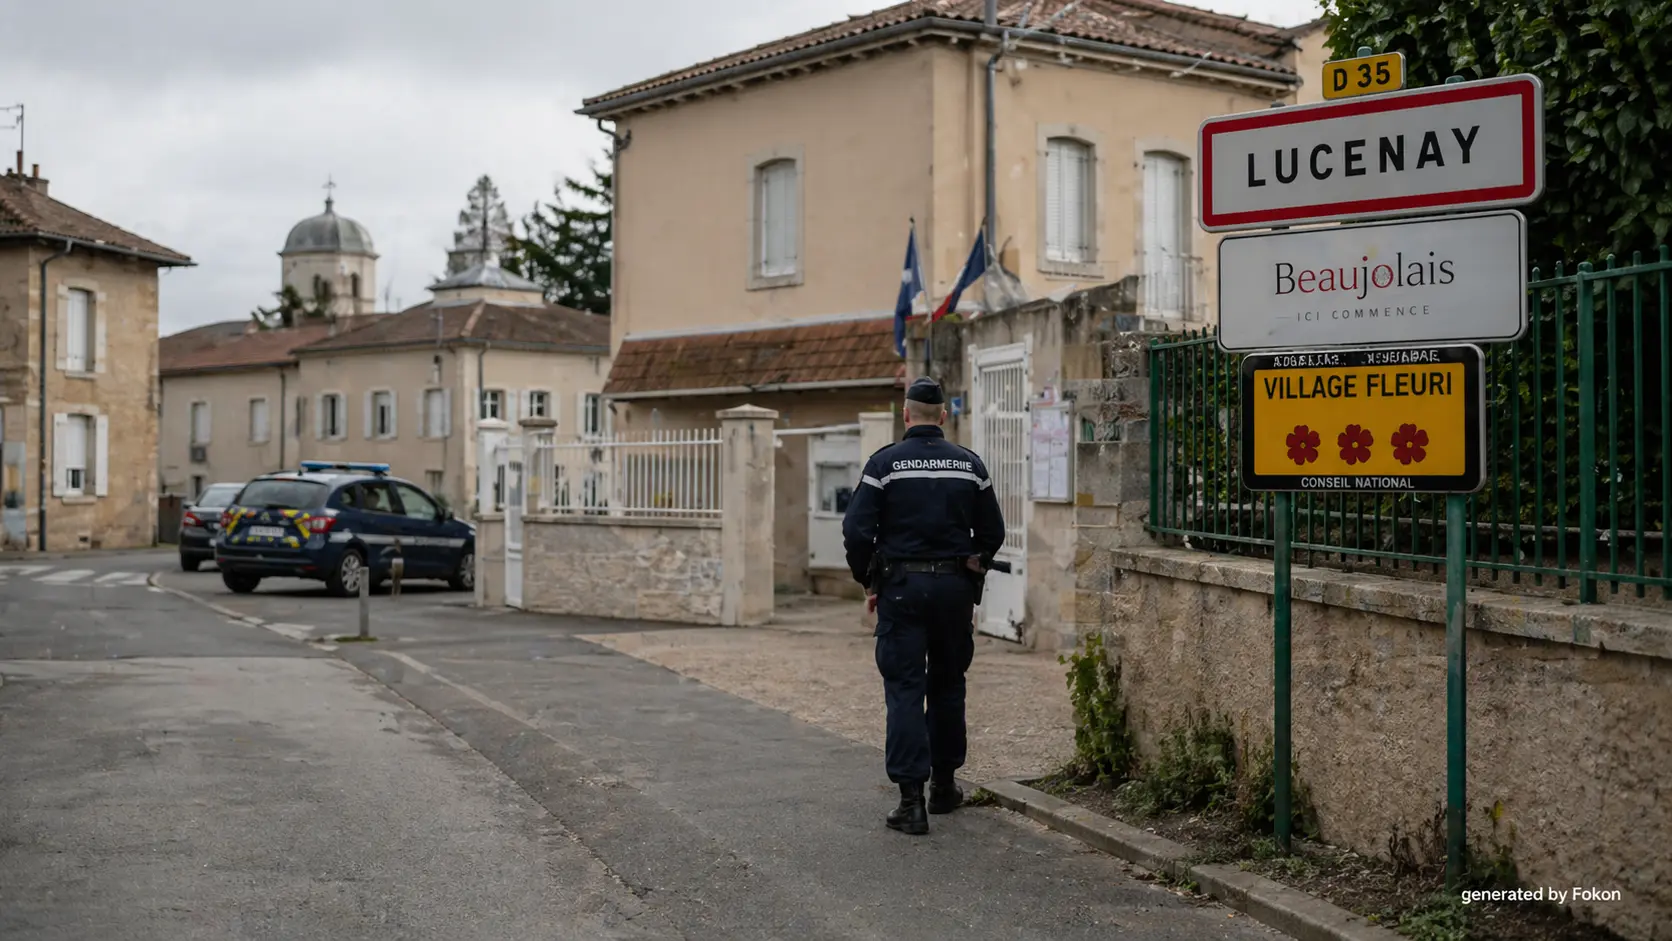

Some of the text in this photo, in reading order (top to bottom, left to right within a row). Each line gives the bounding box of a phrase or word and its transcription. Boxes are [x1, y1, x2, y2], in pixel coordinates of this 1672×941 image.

[1334, 61, 1391, 92] D 35
[1248, 125, 1480, 188] LUCENAY
[1275, 251, 1455, 300] Beaujolais
[1297, 305, 1430, 322] ICI COMMENCE
[1264, 372, 1452, 399] VILLAGE FLEURI
[1301, 477, 1415, 489] CONSEIL NATIONAL
